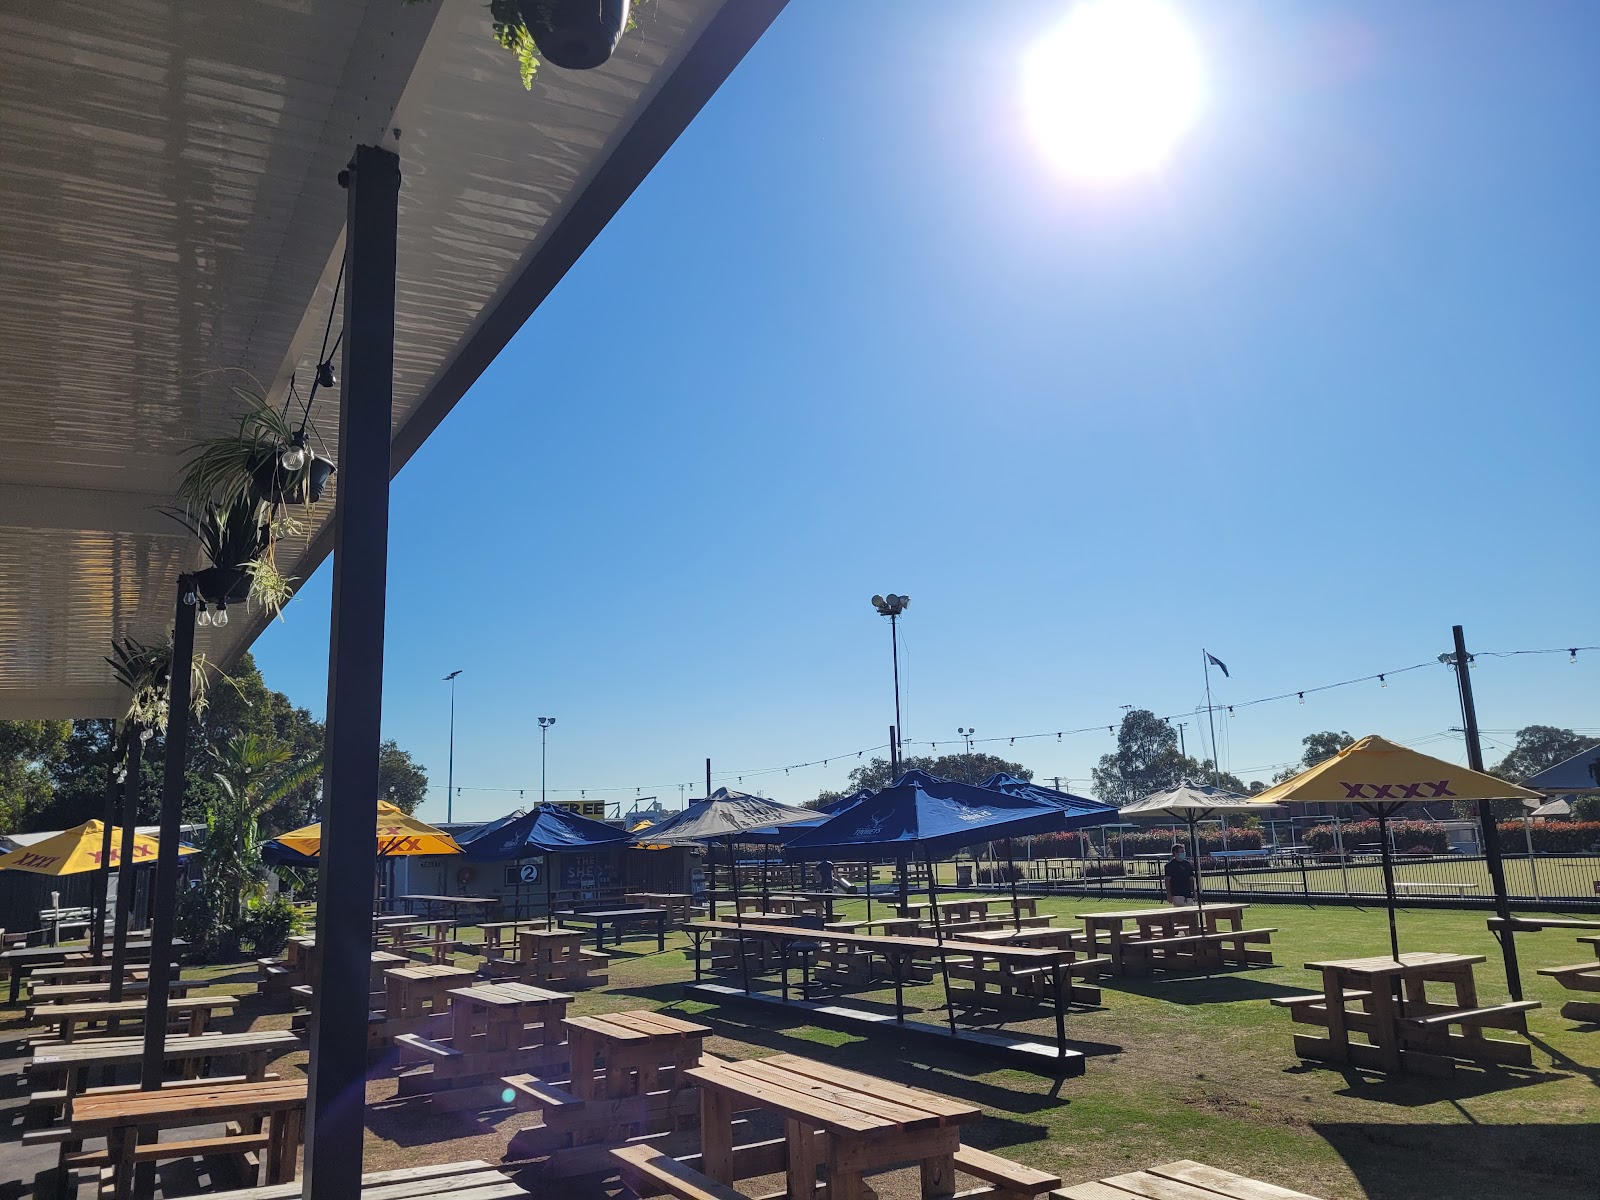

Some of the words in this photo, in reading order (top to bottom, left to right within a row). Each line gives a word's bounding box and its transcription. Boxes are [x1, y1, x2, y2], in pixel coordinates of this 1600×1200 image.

[1339, 780, 1457, 798] XXXX
[13, 852, 60, 869] XXXX
[86, 844, 155, 864] XXX
[576, 856, 595, 866] THE
[525, 866, 535, 881] 2
